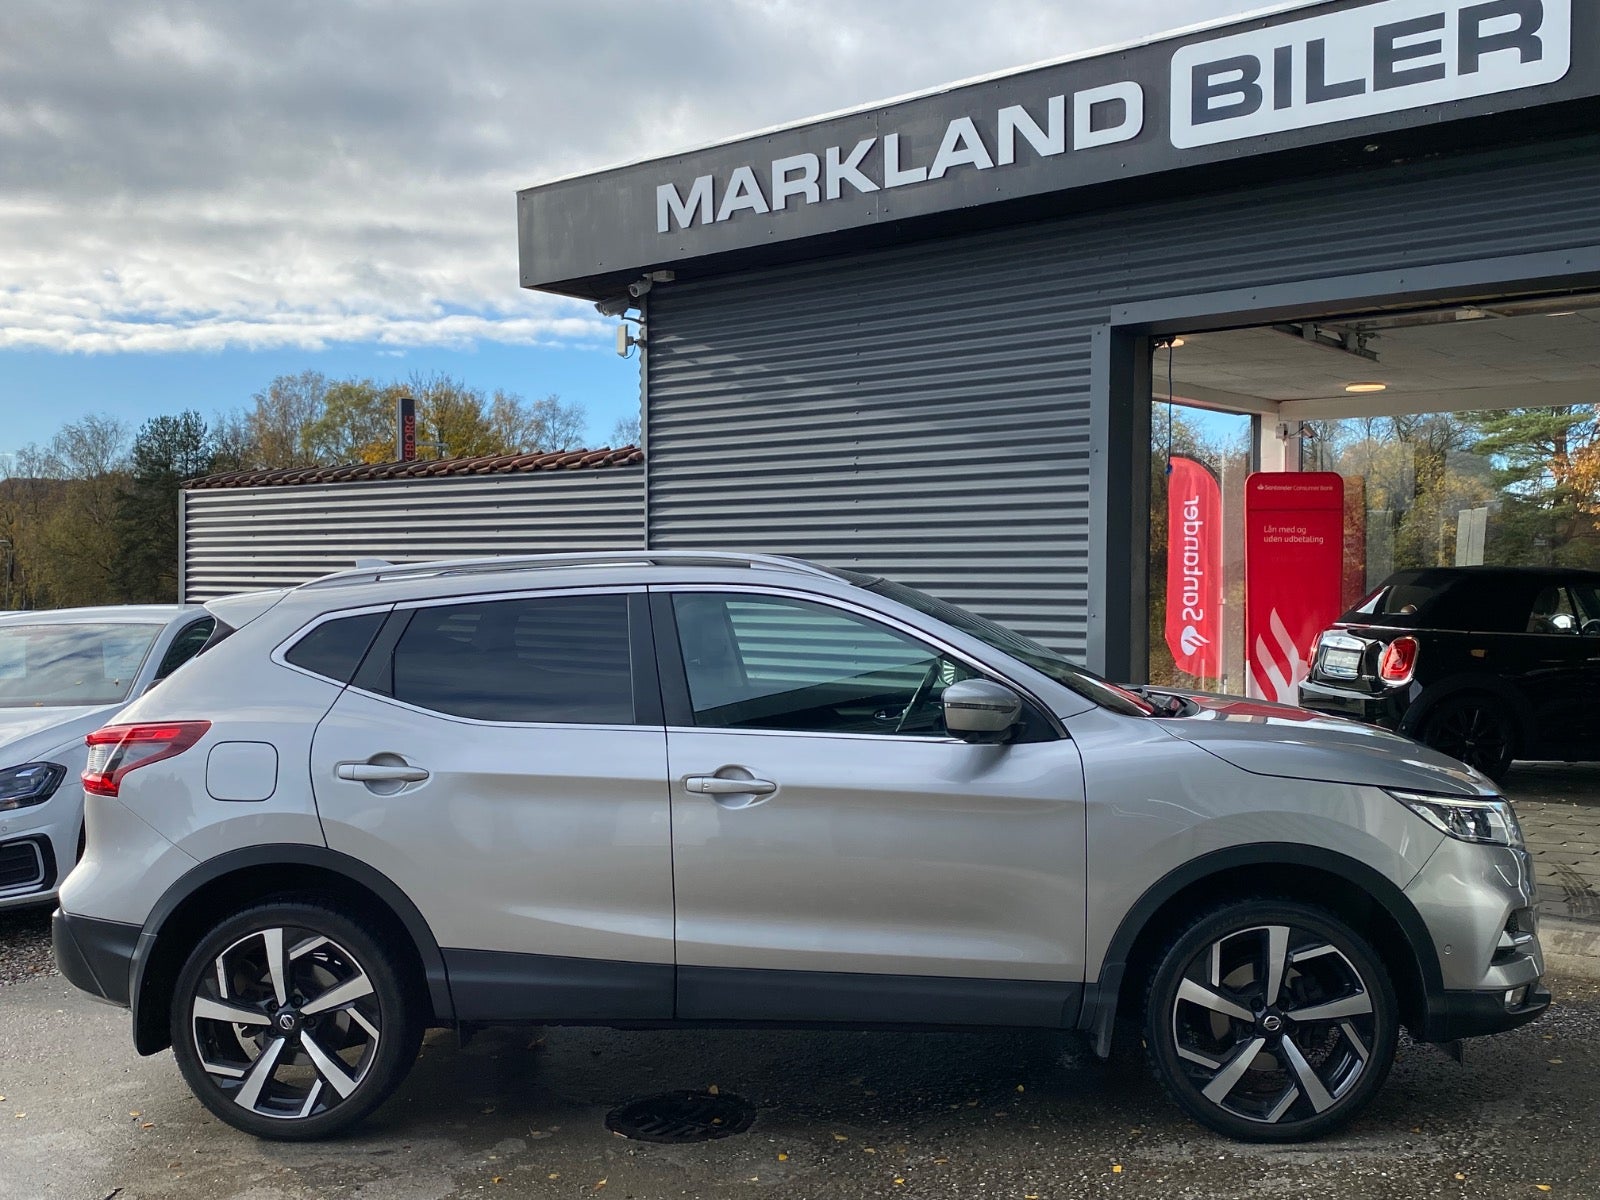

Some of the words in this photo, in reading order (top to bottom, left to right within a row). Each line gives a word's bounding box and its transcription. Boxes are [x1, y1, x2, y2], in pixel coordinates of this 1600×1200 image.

[656, 81, 1144, 233] MARKLAND
[1191, 0, 1544, 126] BILER
[1263, 525, 1277, 533] Lån
[1297, 527, 1306, 535] og
[1263, 535, 1283, 543] uden
[1284, 535, 1324, 545] udbetaling
